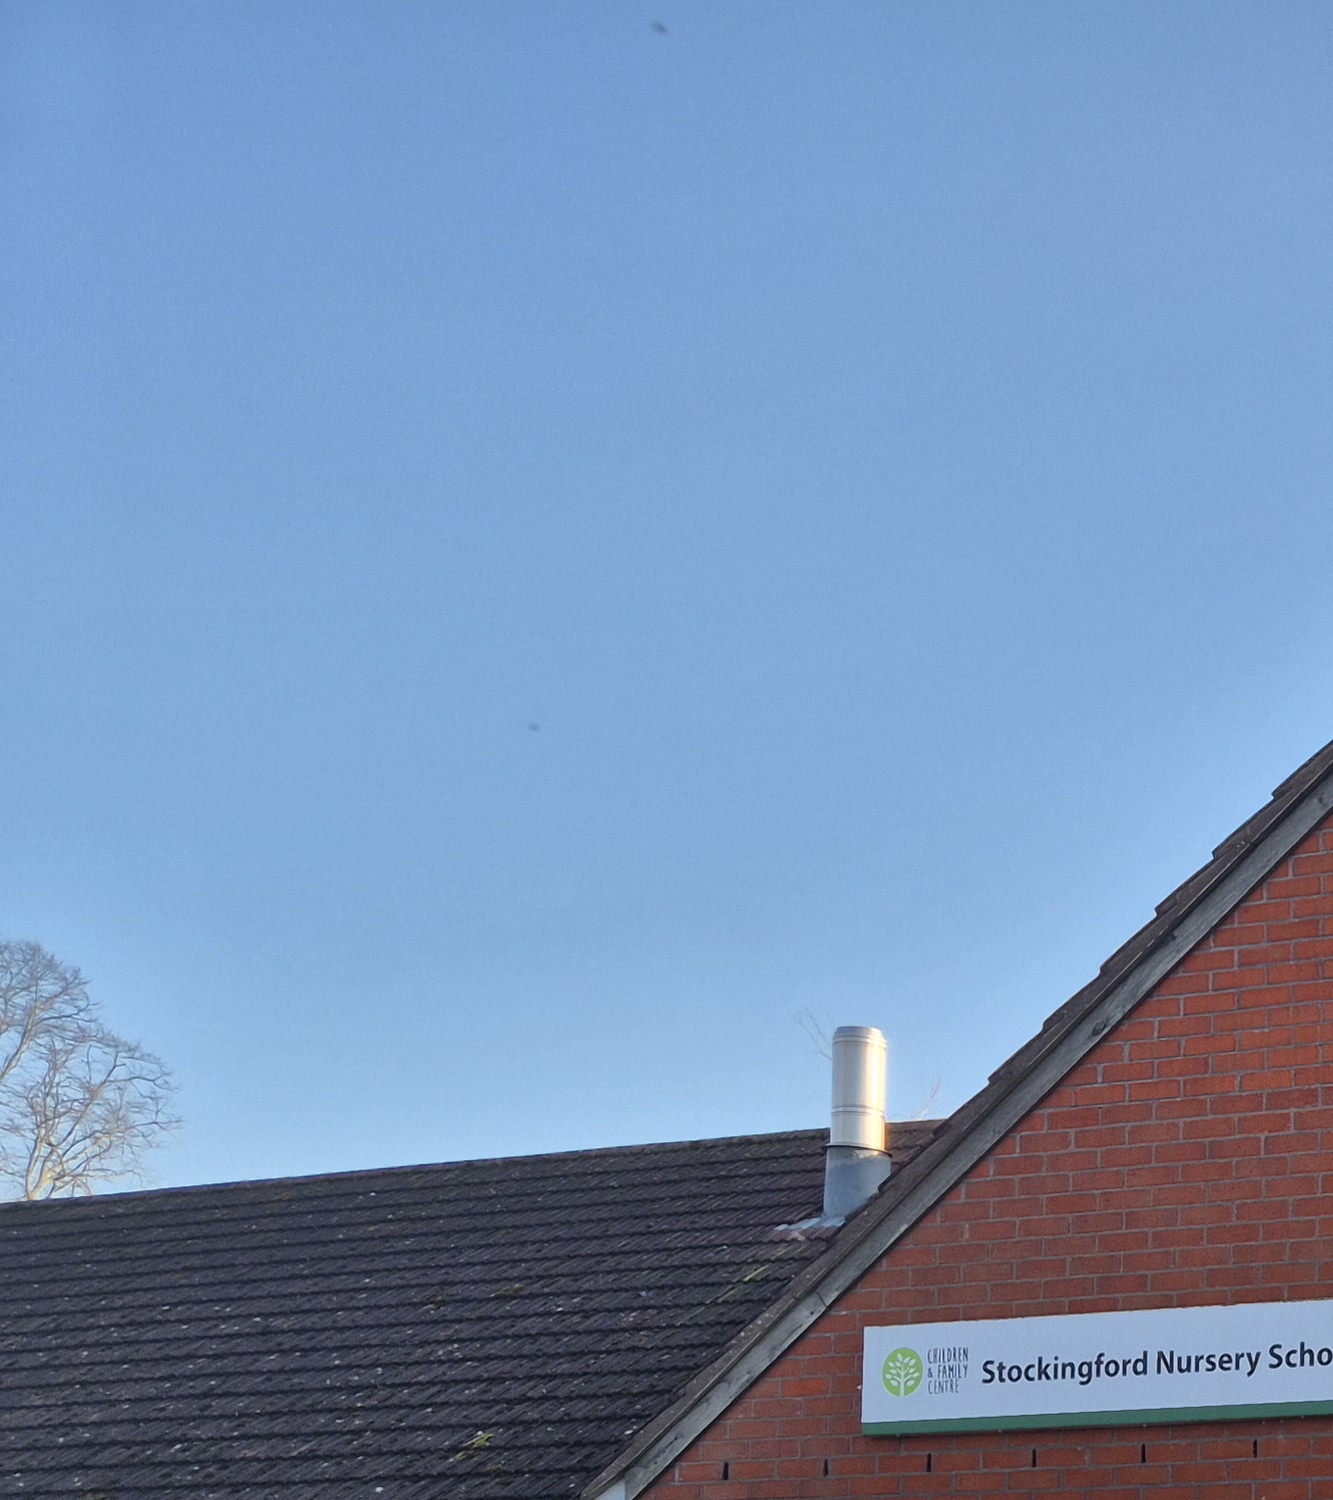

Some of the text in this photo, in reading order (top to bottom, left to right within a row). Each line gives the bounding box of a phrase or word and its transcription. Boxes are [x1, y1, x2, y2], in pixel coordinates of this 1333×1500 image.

[928, 1347, 969, 1364] CHILDREN
[927, 1364, 969, 1379] & FAMILY
[981, 1350, 1149, 1385] Stockingford
[1156, 1350, 1261, 1377] Nursery
[928, 1380, 960, 1394] CENTRE
